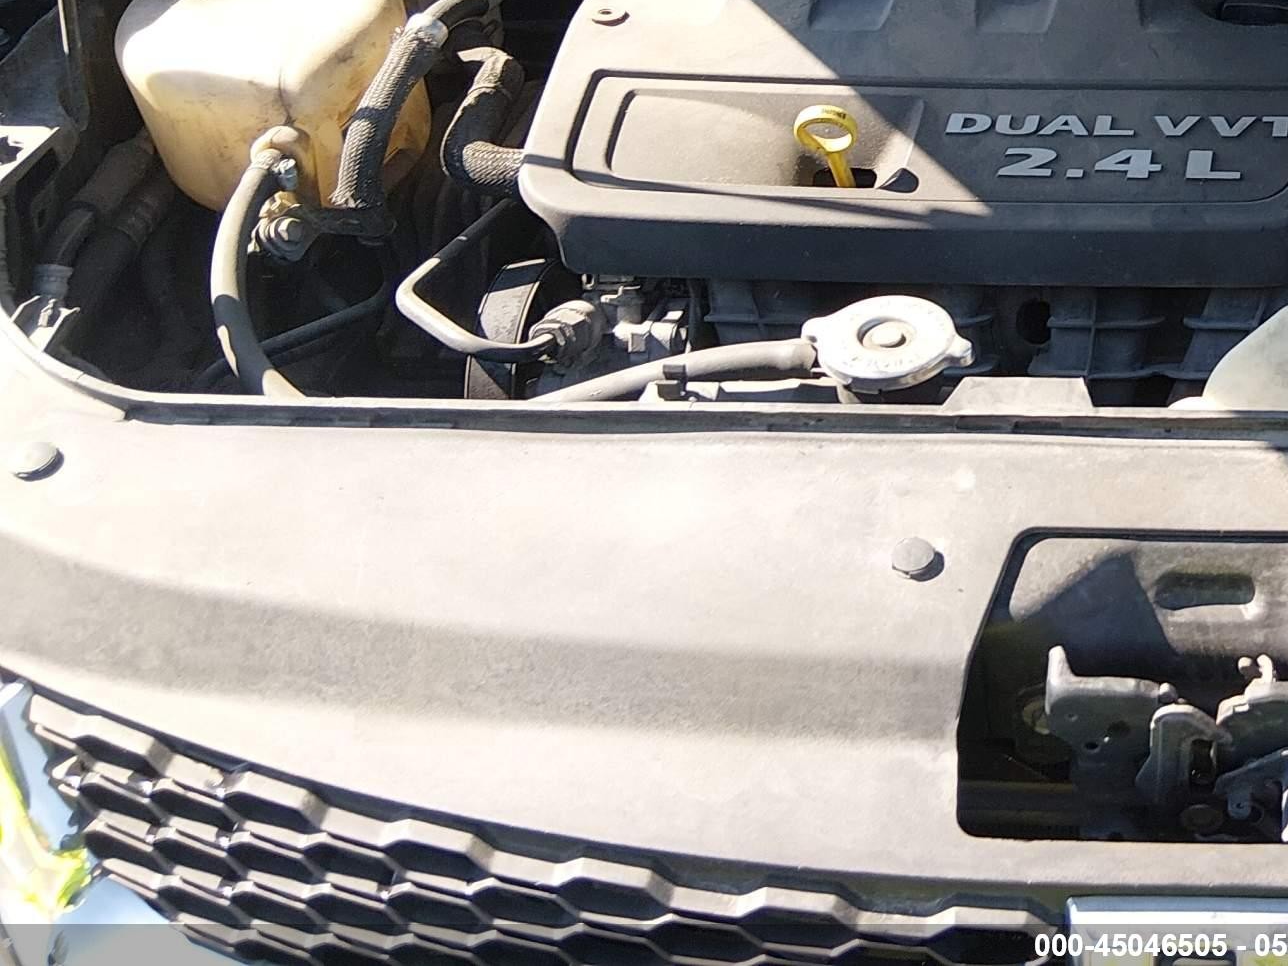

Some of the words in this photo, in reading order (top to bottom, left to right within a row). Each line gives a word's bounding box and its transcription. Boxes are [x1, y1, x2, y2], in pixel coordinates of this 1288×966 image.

[945, 112, 1135, 137] DUAL
[996, 147, 1163, 180] 2.4
[1184, 149, 1241, 180] L
